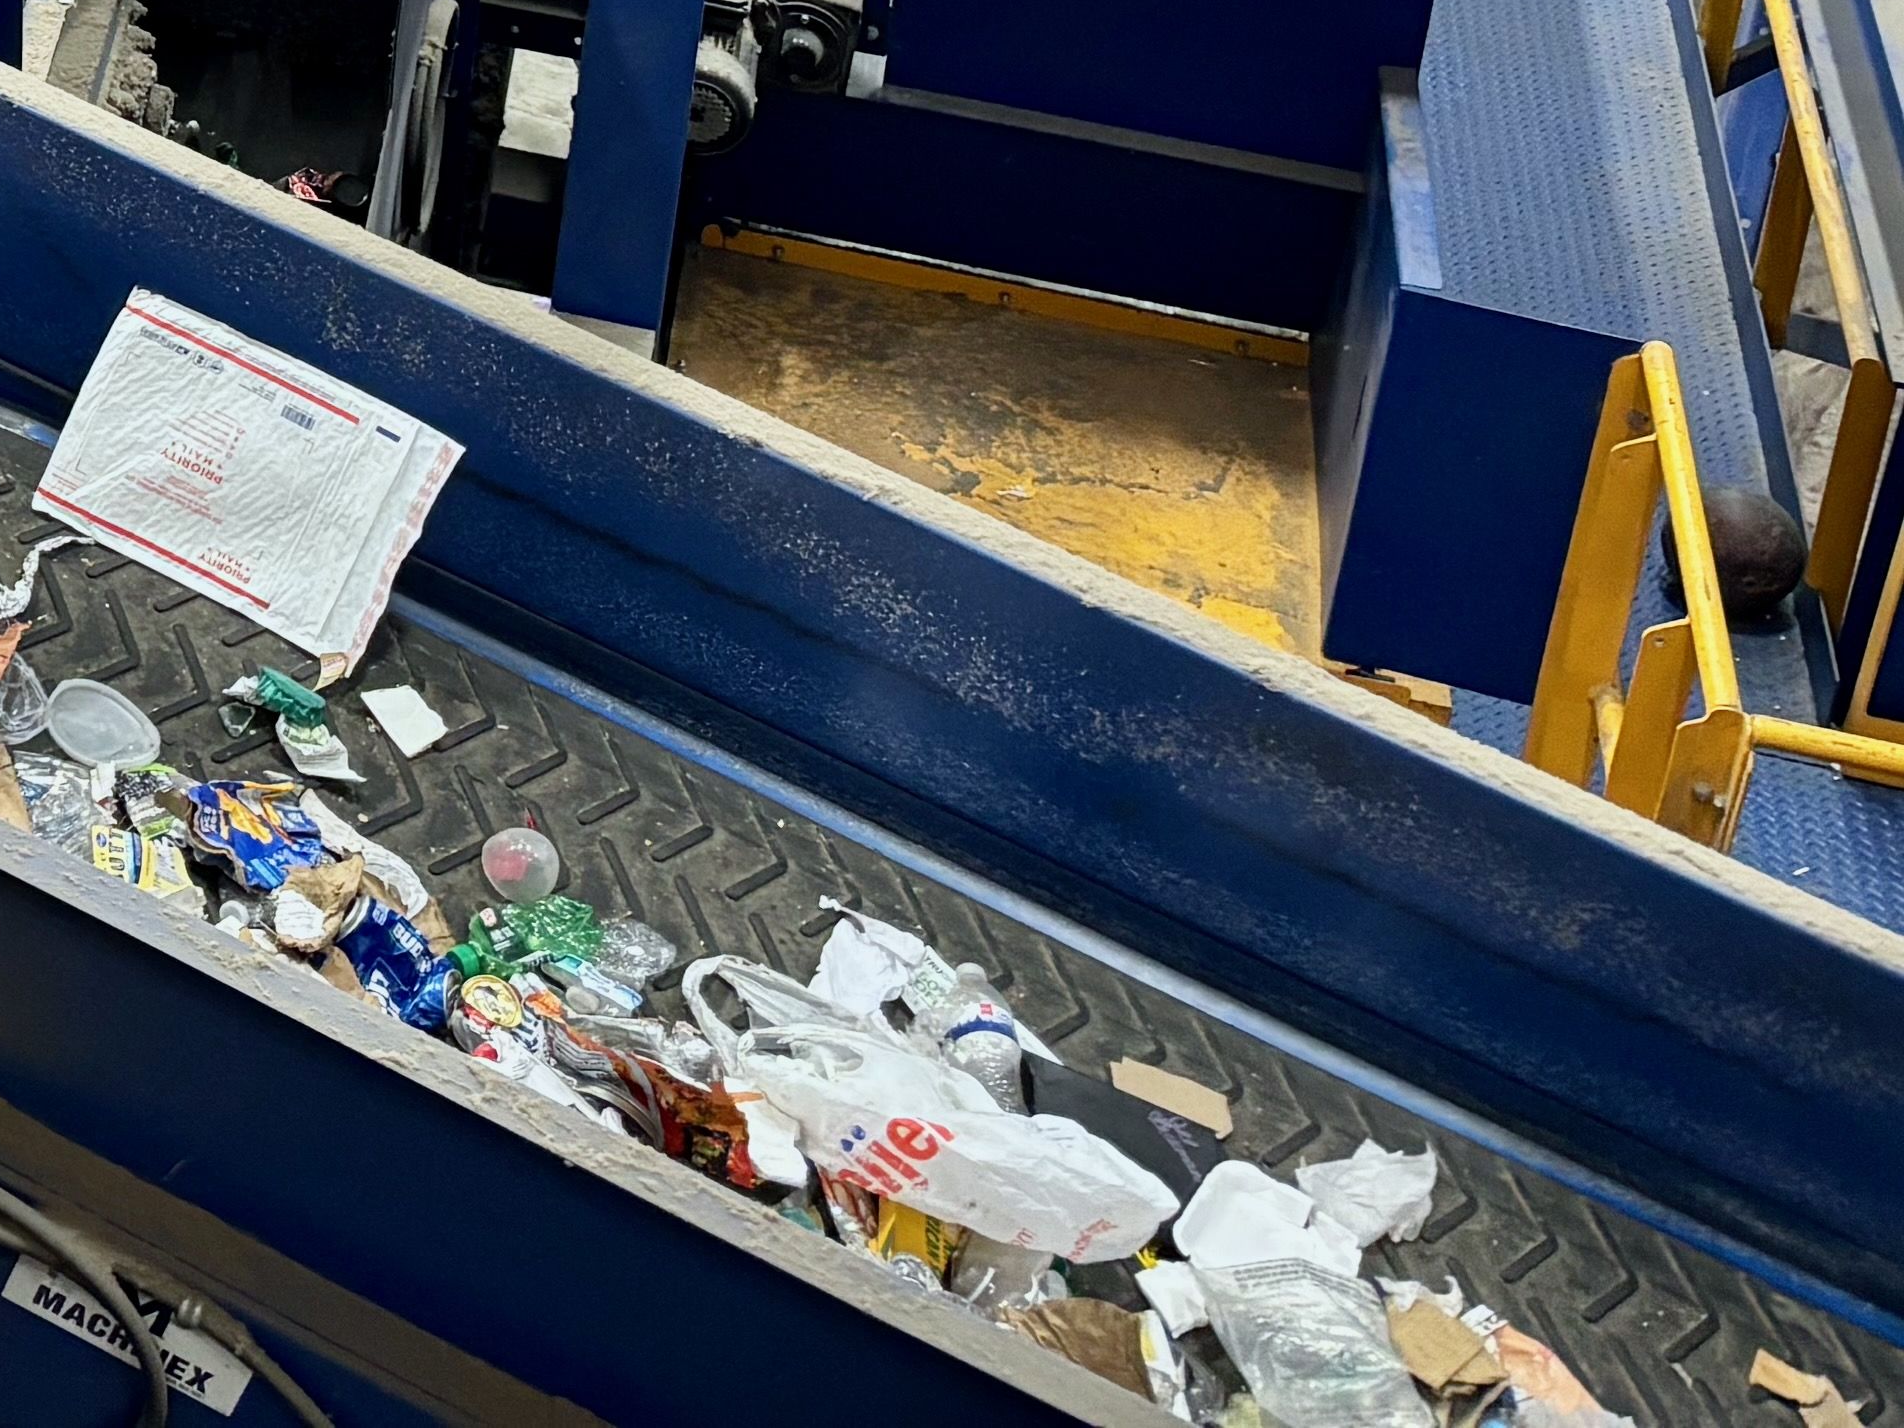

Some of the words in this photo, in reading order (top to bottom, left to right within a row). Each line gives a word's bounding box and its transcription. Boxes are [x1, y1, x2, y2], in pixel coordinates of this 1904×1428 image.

[161, 447, 223, 485] PRIORITY
[197, 551, 251, 584] PRIORITY
[392, 922, 423, 957] BUD
[32, 1284, 214, 1394] MACHEX
